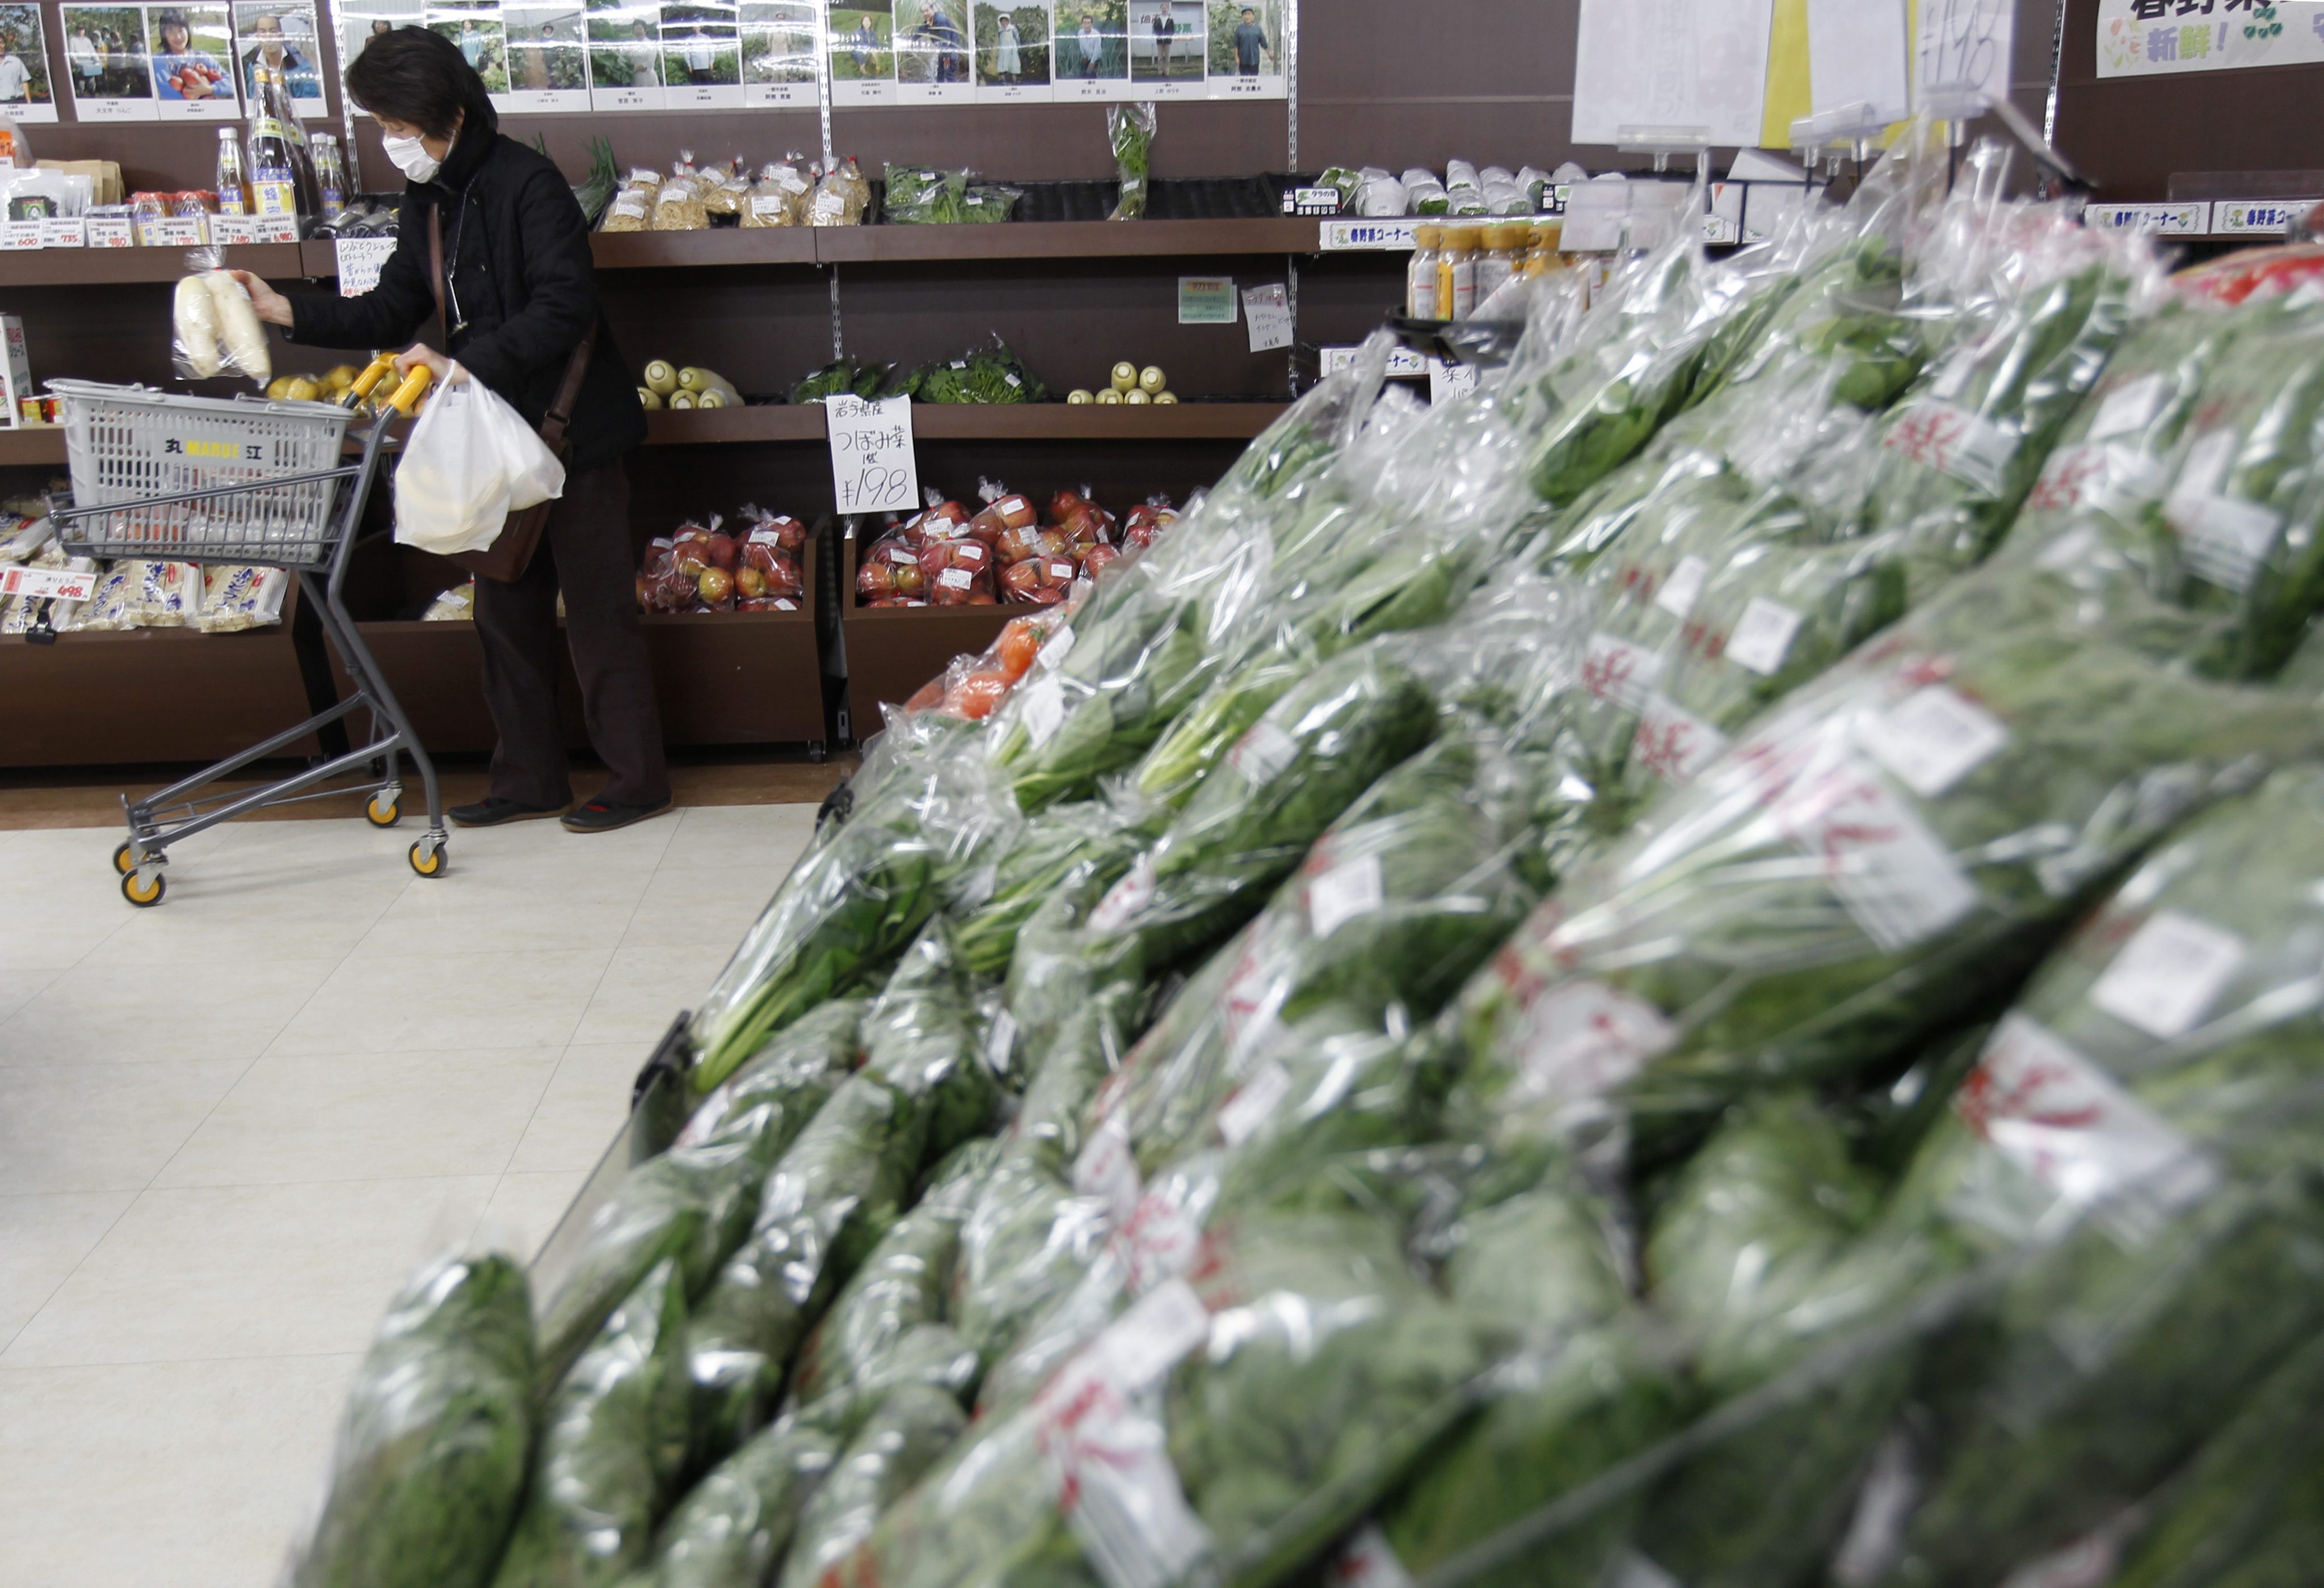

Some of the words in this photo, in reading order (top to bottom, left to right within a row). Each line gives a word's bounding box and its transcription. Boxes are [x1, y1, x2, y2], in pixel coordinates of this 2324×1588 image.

[2146, 22, 2229, 62] 新鮮!
[18, 238, 38, 246] 600
[1350, 226, 1411, 243] 春野菜コーナー
[835, 399, 885, 418] 岩手県産
[165, 437, 183, 454] 丸
[186, 440, 240, 458] MARUE
[246, 445, 263, 460] 江
[835, 424, 906, 452] つぼみ菜
[842, 466, 908, 507] ¥198
[57, 584, 83, 597] 498
